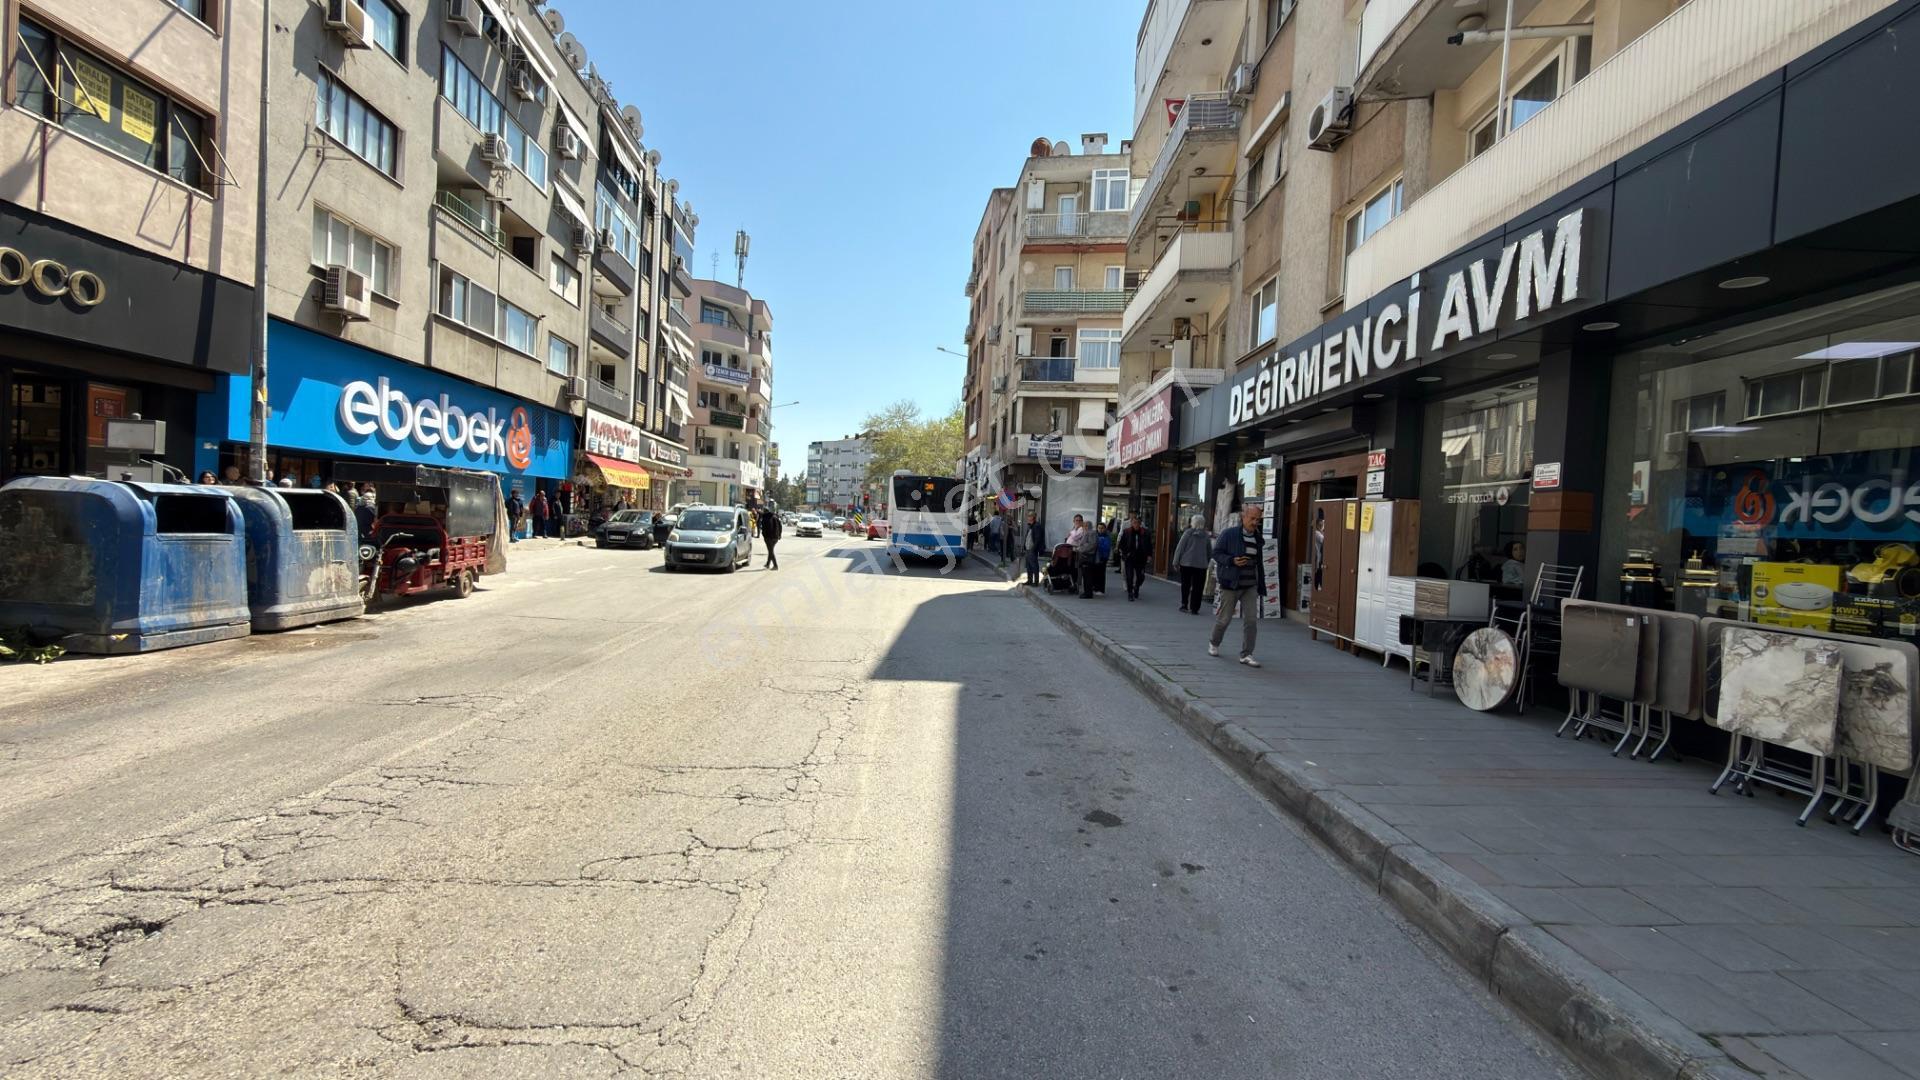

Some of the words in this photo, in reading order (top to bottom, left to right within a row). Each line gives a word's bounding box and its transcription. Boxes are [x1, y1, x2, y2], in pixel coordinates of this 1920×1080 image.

[1229, 272, 1420, 426] DEĞİRMENCİ
[1430, 207, 1584, 351] AVM
[339, 376, 506, 457] ebebek
